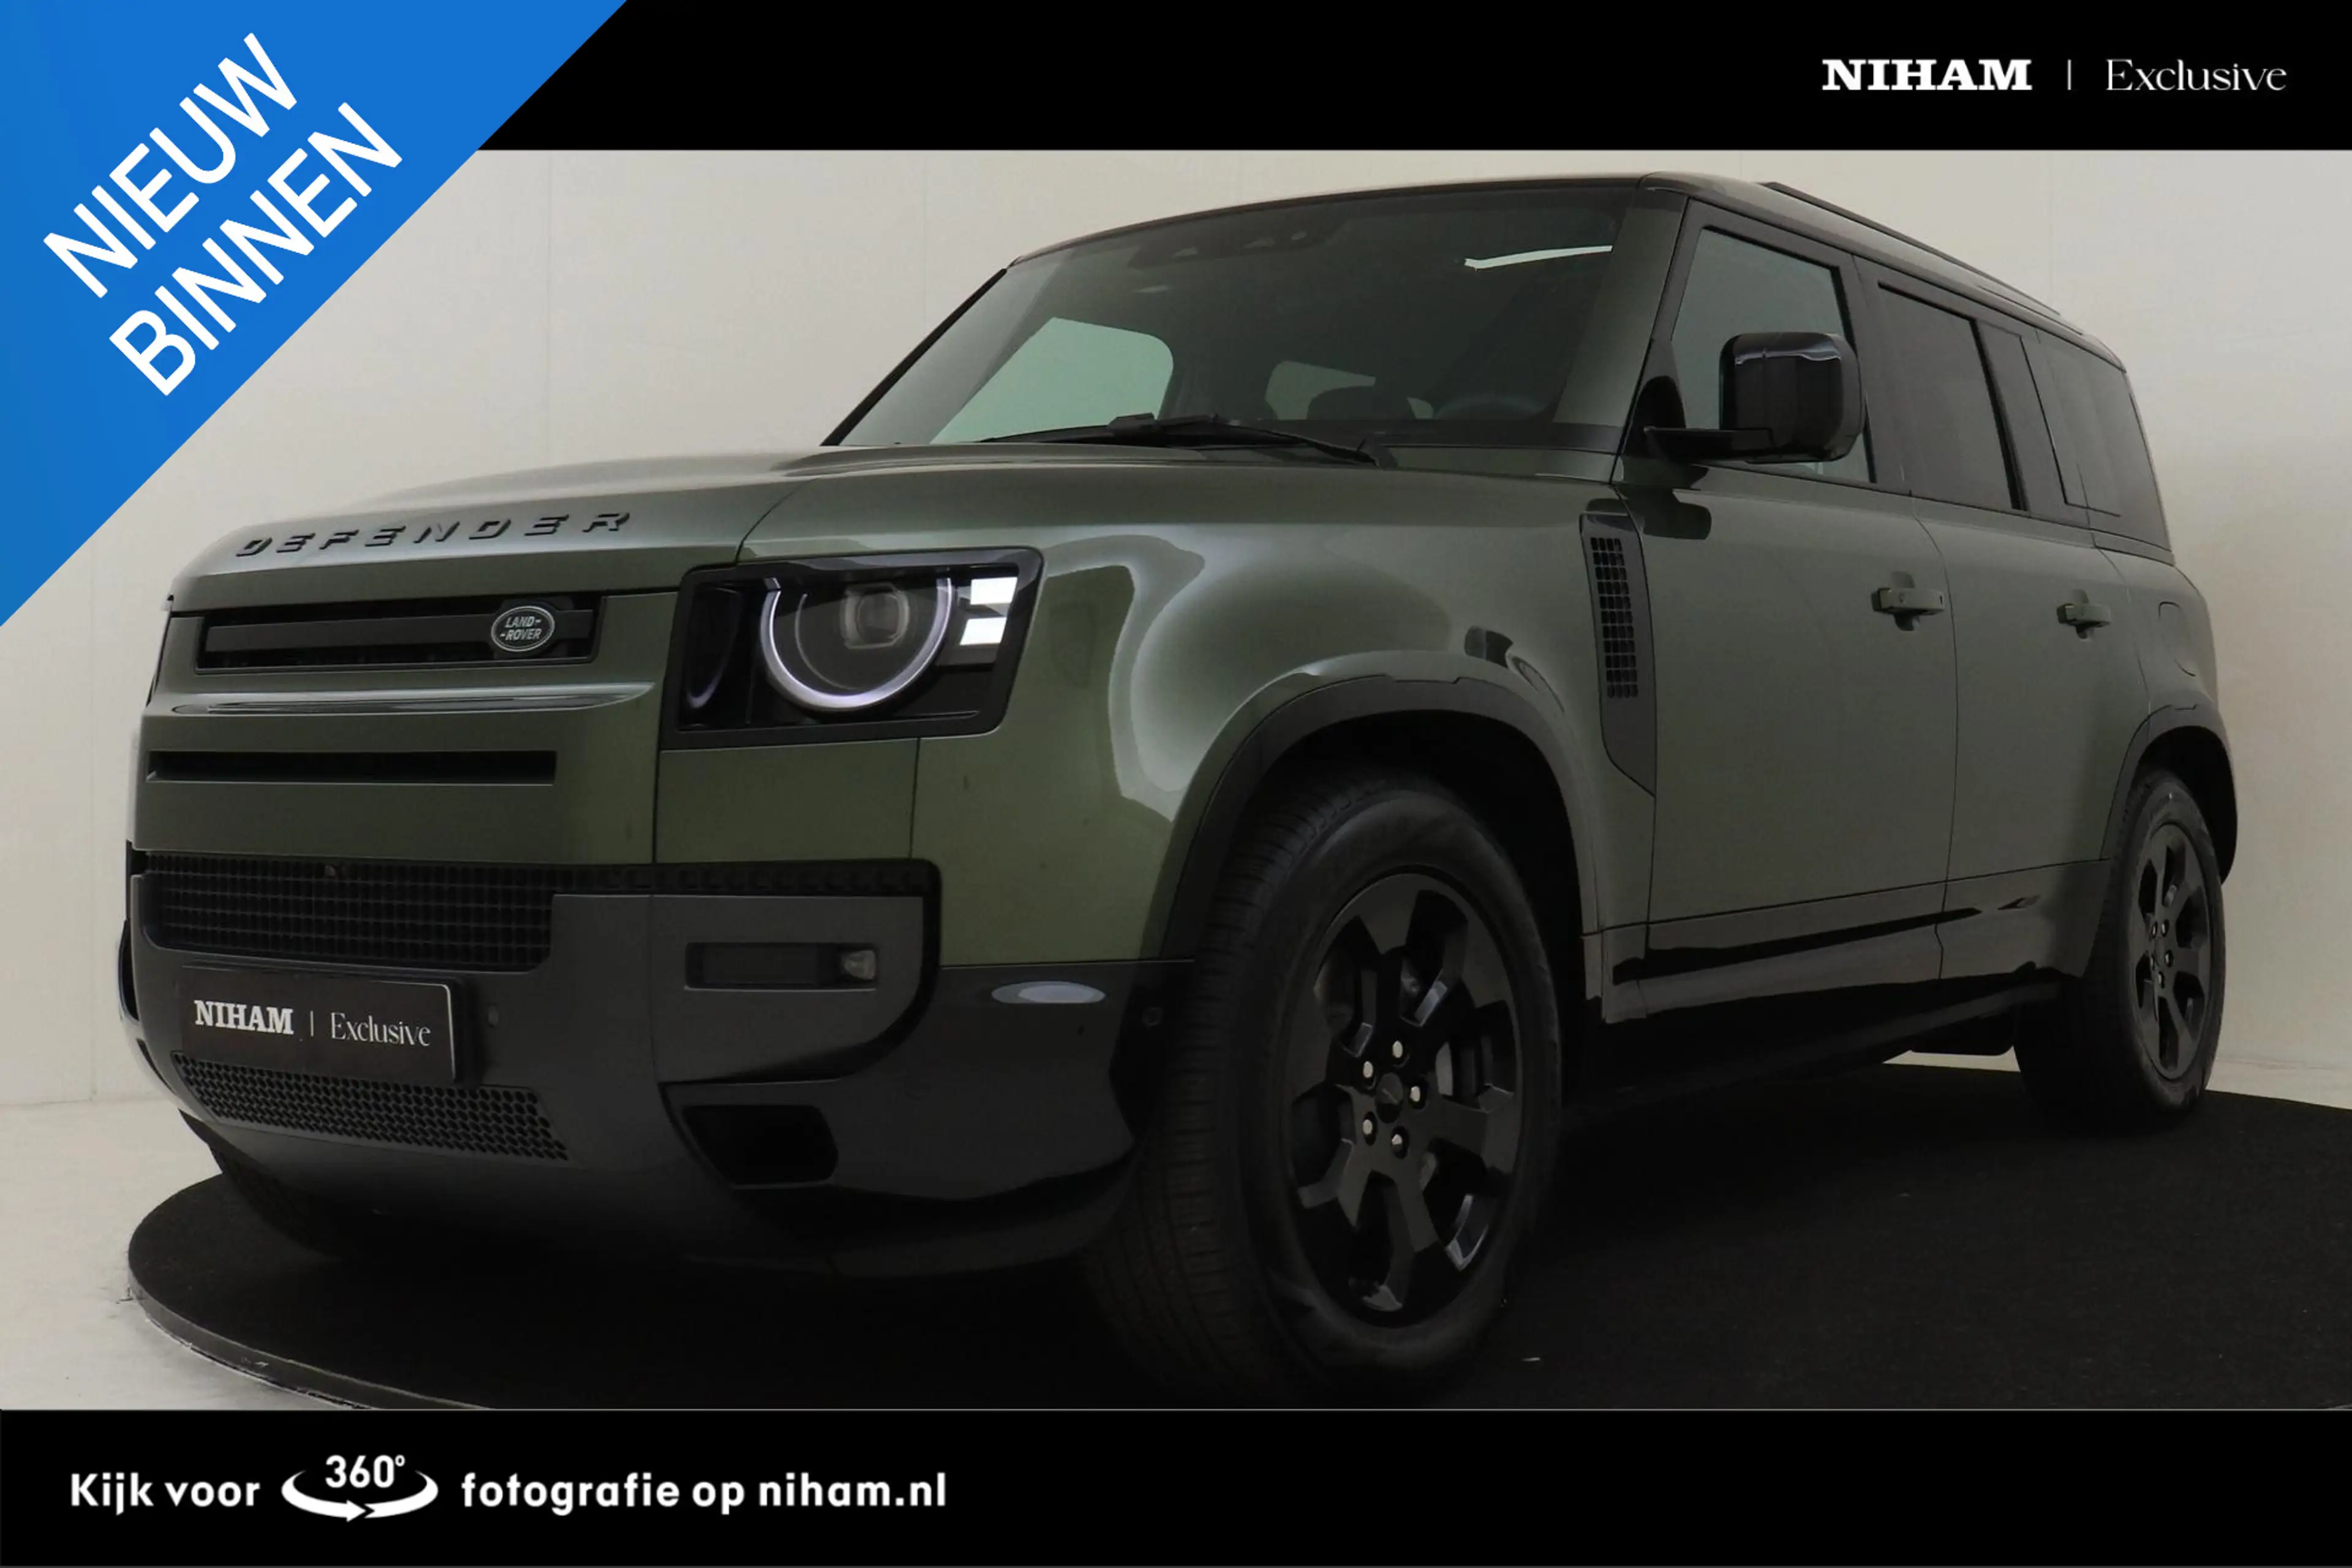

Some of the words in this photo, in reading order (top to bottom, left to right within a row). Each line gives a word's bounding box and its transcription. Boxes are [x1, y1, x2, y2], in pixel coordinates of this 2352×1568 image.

[236, 512, 630, 557] DEFENDER
[194, 999, 295, 1035] NIHAM
[331, 1012, 432, 1047] Exclusive
